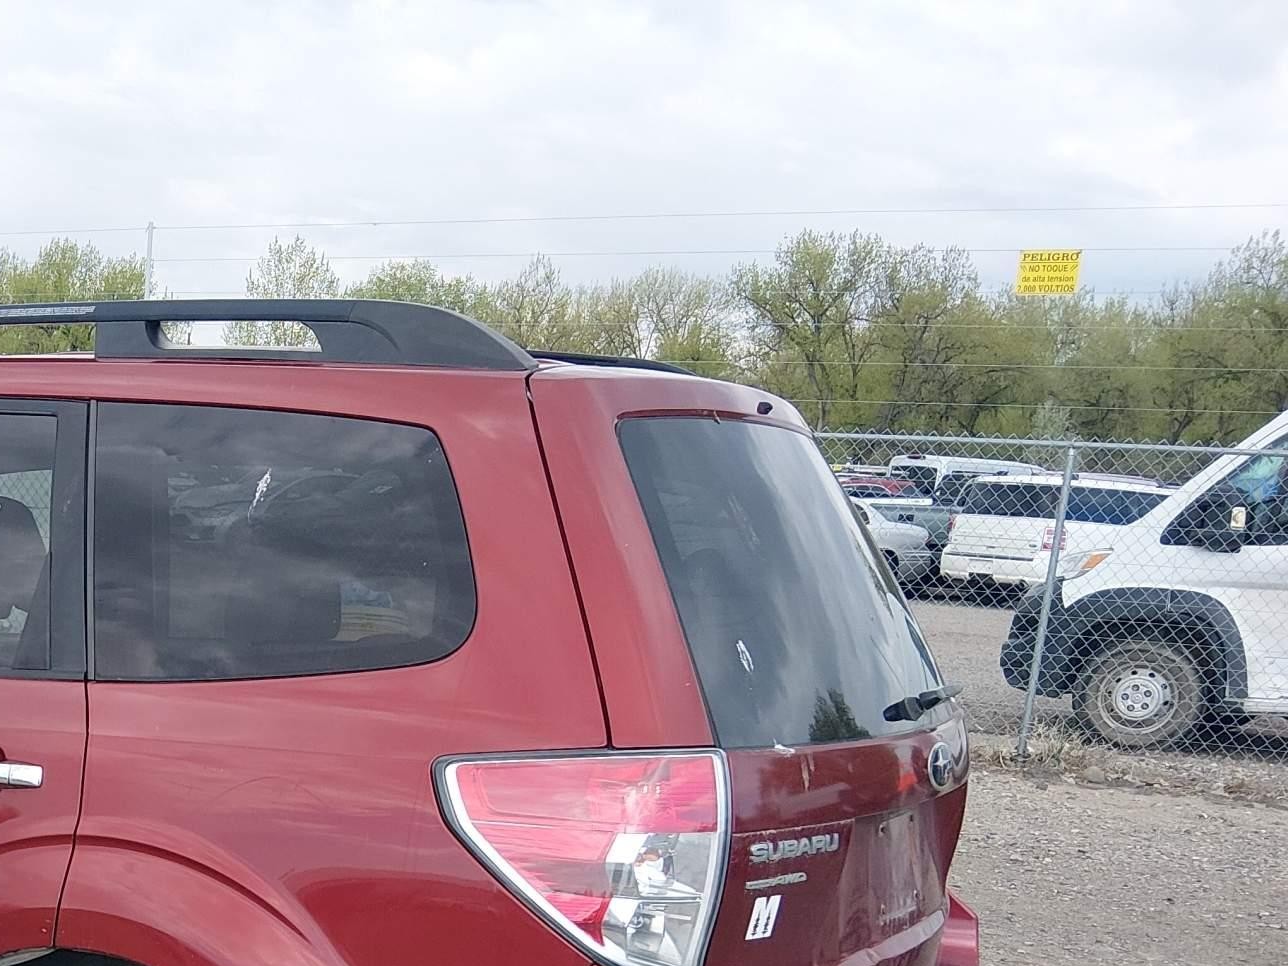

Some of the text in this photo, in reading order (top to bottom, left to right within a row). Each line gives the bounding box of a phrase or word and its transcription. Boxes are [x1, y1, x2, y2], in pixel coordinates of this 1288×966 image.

[1022, 252, 1080, 261] PELIGRO
[1028, 264, 1069, 272] NO TOQUE
[1038, 284, 1075, 293] VOLTIOS
[749, 832, 840, 863] SUBARU
